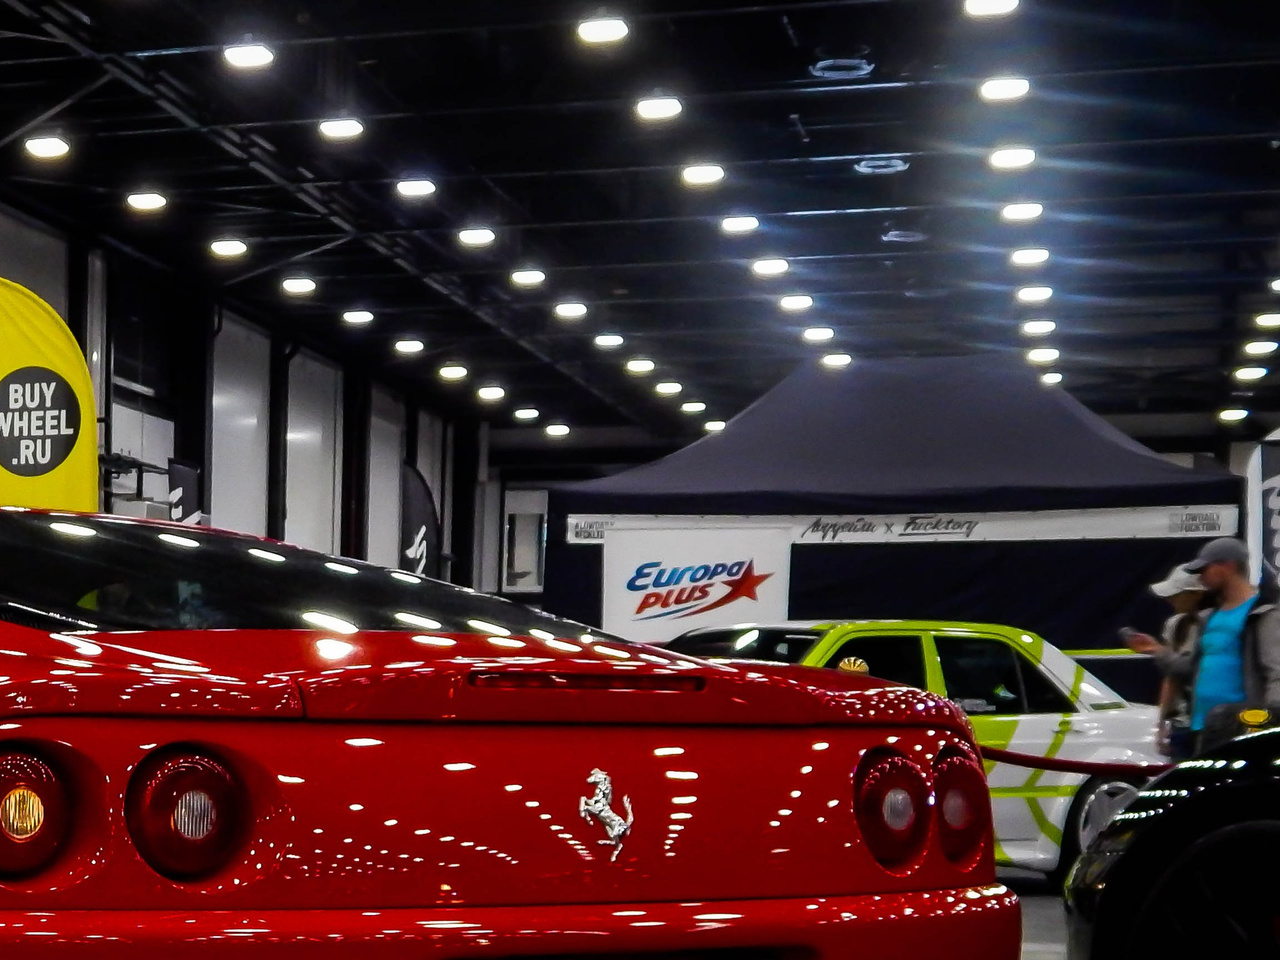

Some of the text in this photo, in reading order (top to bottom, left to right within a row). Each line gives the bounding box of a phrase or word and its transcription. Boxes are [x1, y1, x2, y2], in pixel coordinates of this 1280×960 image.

[8, 382, 57, 409] BUY
[12, 438, 52, 465] .RU
[626, 560, 748, 592] Europa
